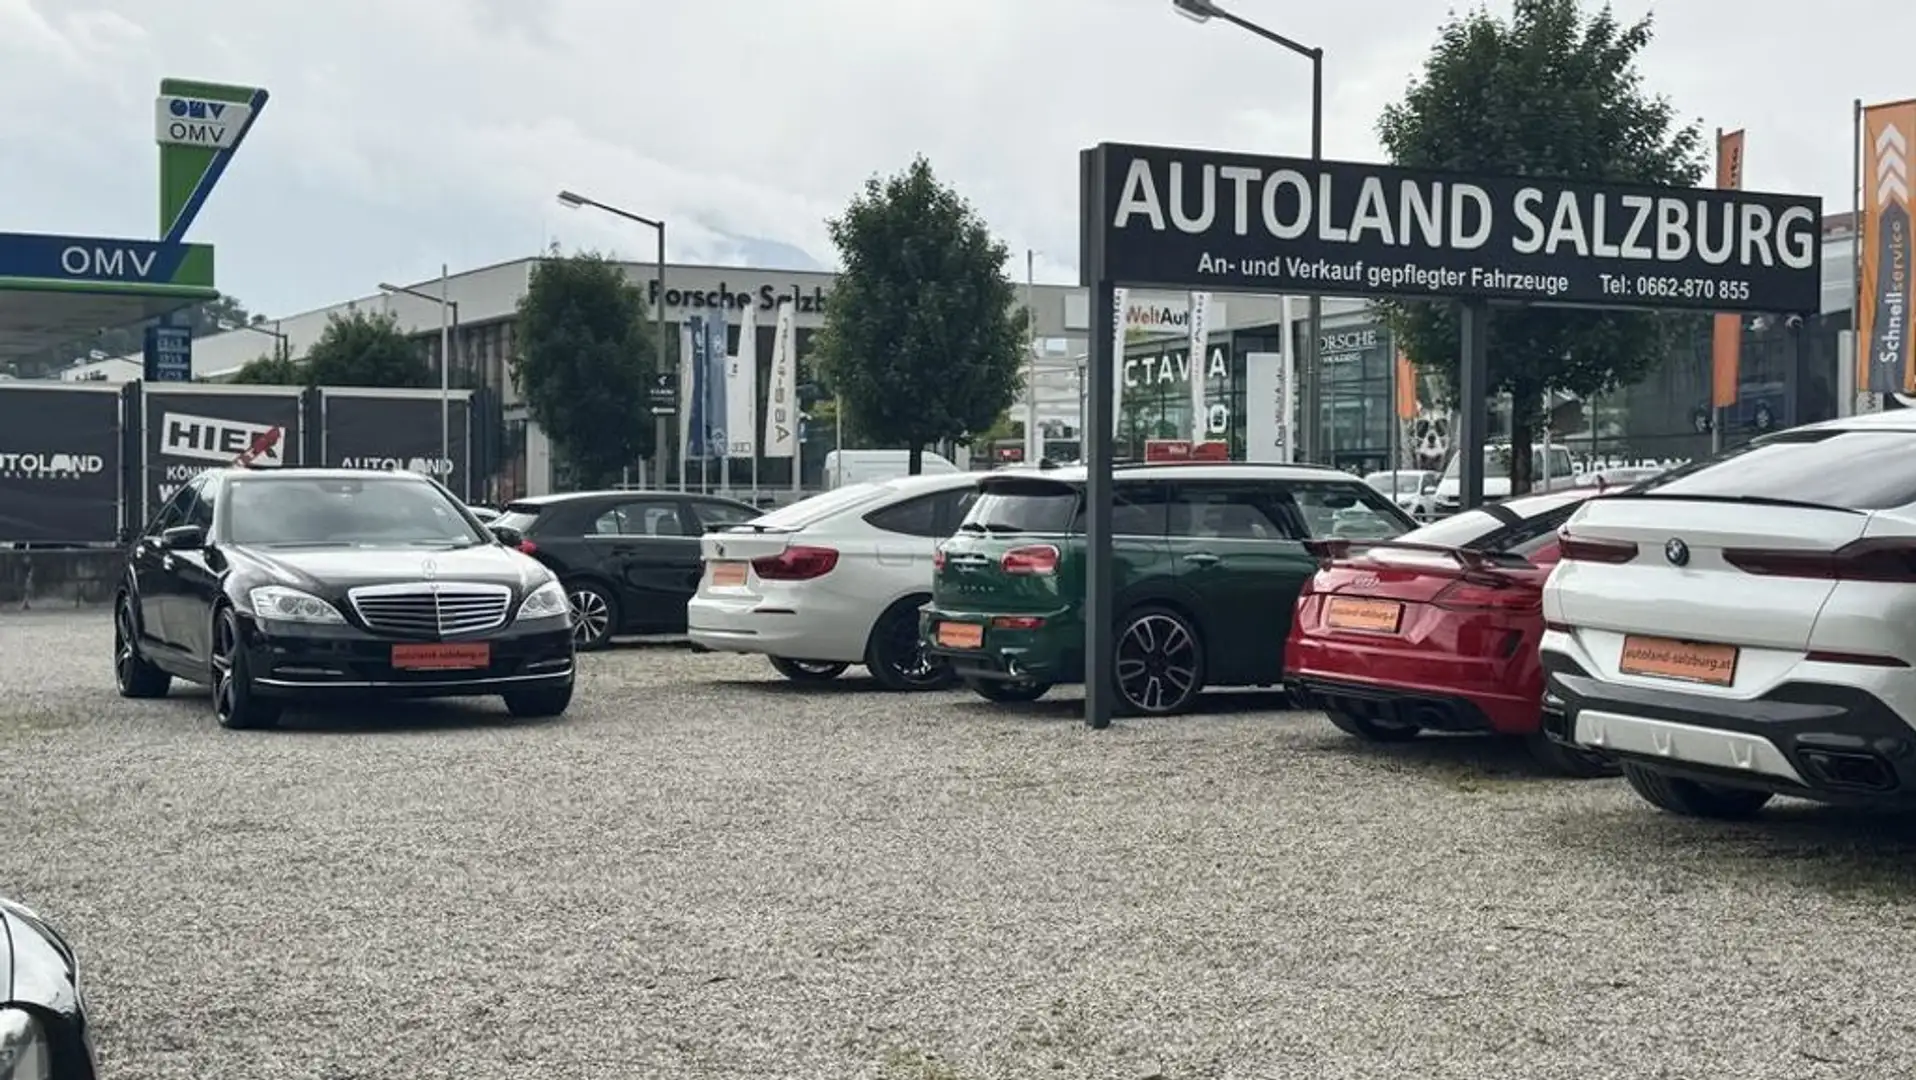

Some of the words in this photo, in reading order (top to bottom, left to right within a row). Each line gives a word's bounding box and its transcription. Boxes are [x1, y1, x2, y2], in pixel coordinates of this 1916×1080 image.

[170, 123, 226, 143] OMV
[1114, 158, 1493, 250] AUTOLAND
[1512, 186, 1814, 269] SALZBURG
[61, 246, 157, 277] OMV
[1198, 252, 1236, 274] An-
[1242, 256, 1280, 277] und
[1286, 257, 1363, 281] Verkauf
[1368, 263, 1467, 290] gepflegter
[1472, 267, 1569, 296] Fahrzeuge
[1600, 273, 1632, 295] Tel:
[1637, 276, 1715, 299] 0662-870
[1720, 280, 1749, 300] 855
[759, 284, 827, 312] Slzb
[1879, 219, 1904, 363] Schnellservice
[1126, 305, 1189, 325] WeltAut
[1320, 329, 1377, 351] ORSCHE
[1124, 348, 1227, 388] CTAVA
[1626, 648, 1731, 671] autoland-salzburg.at
